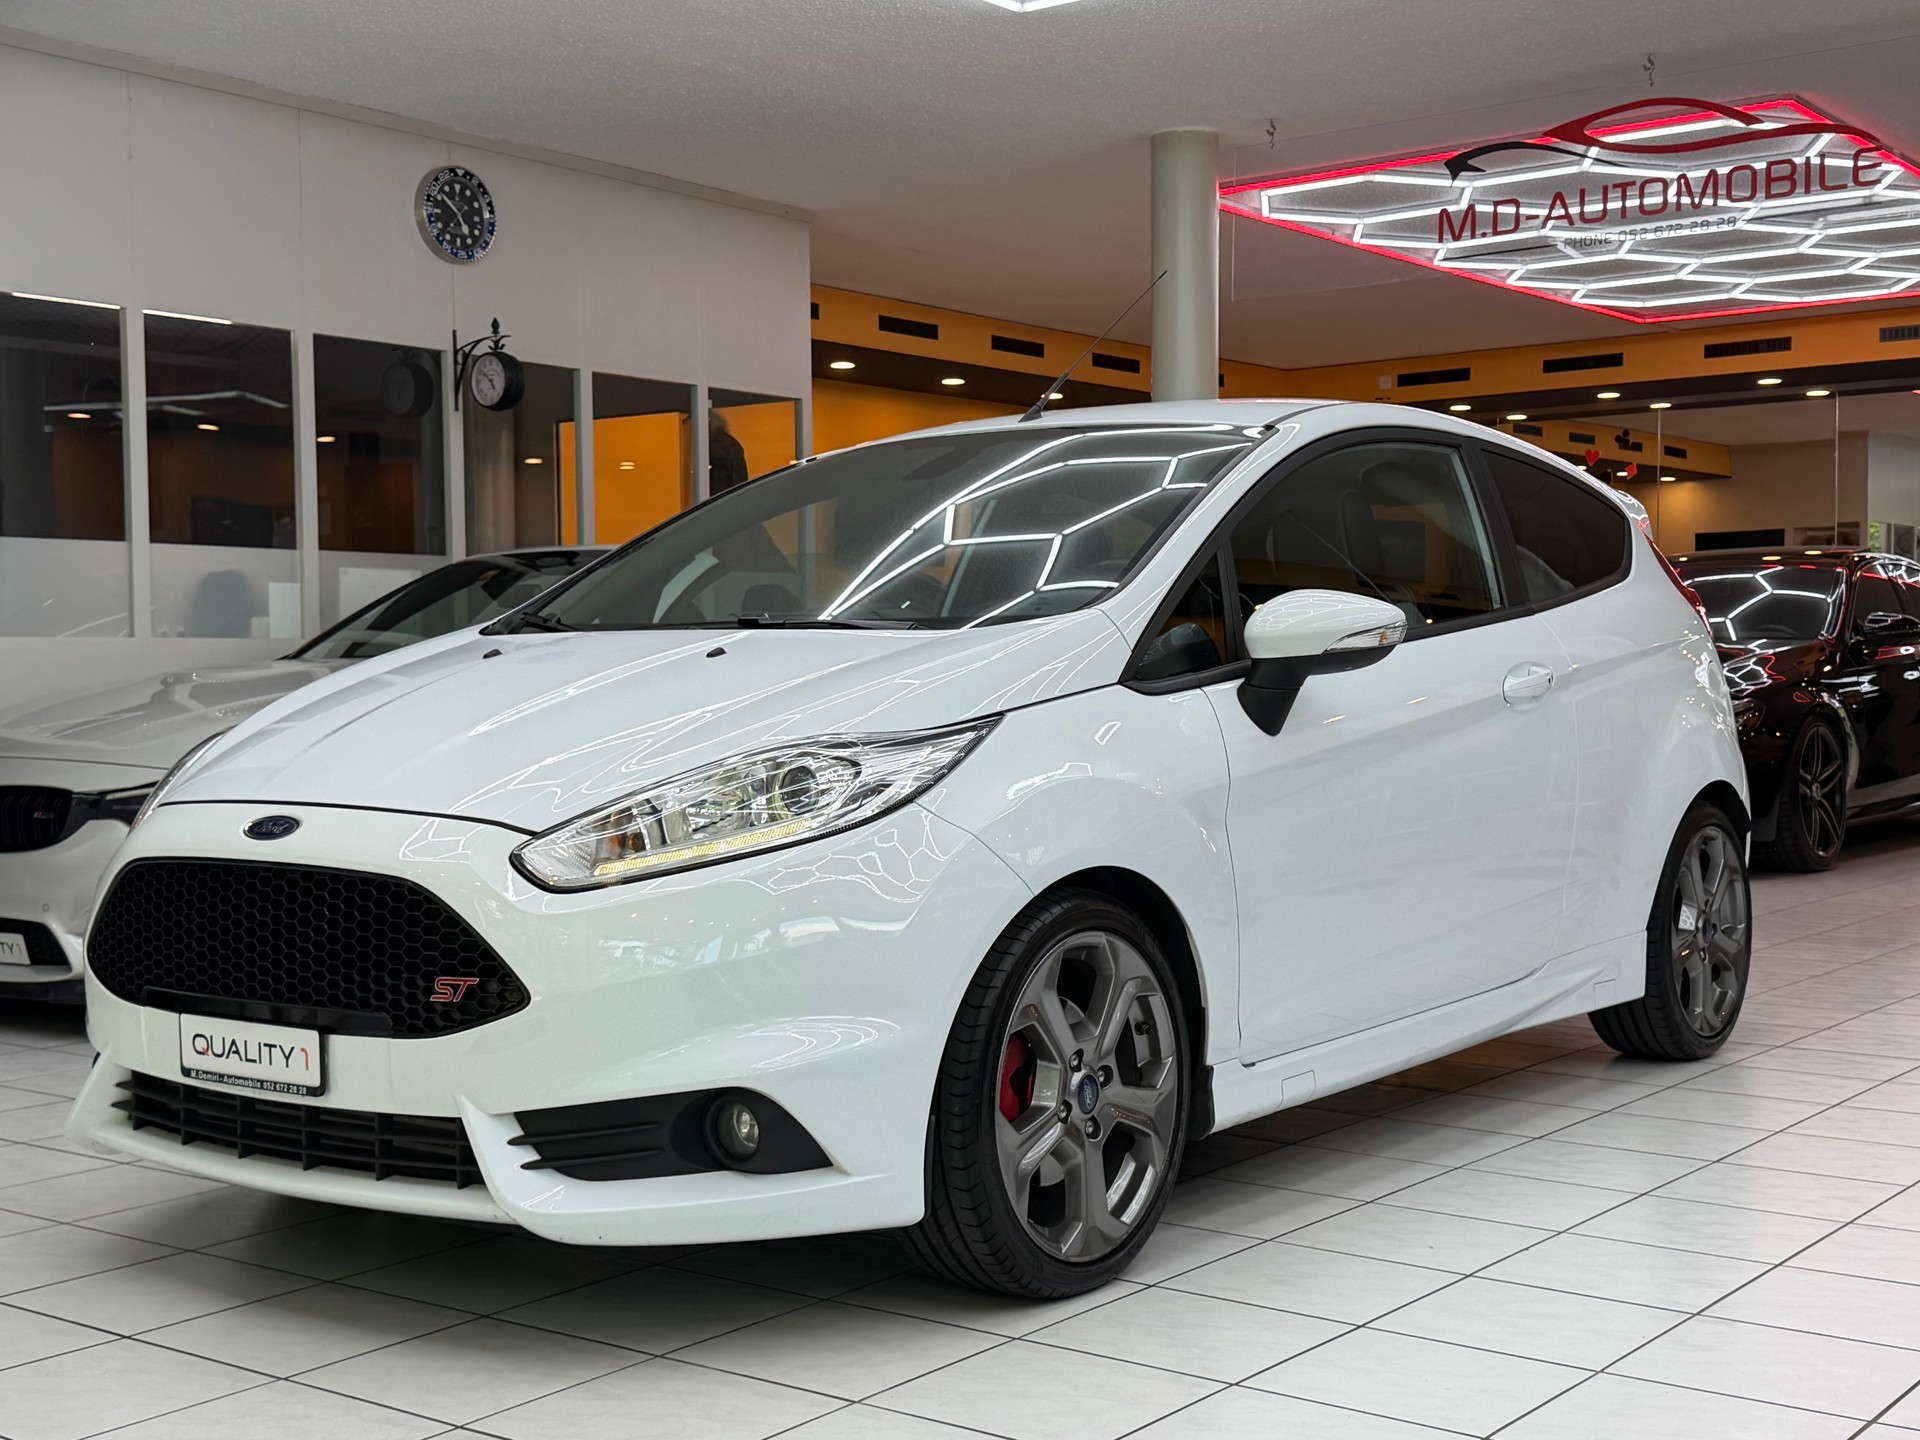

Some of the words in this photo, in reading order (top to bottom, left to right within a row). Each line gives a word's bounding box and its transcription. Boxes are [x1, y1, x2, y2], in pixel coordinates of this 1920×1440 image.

[1438, 145, 1882, 243] M.D-AUTOMOBILE
[1563, 232, 1612, 249] PHONE
[1618, 230, 1648, 242] 052
[1654, 223, 1683, 238] 672
[1689, 219, 1709, 232] 28
[1716, 216, 1737, 229] 28
[430, 977, 479, 1002] ST
[223, 1075, 261, 1088] Automobile
[263, 1081, 275, 1090] 052
[276, 1083, 287, 1092] 672
[288, 1085, 297, 1093] 28
[298, 1086, 307, 1094] 28
